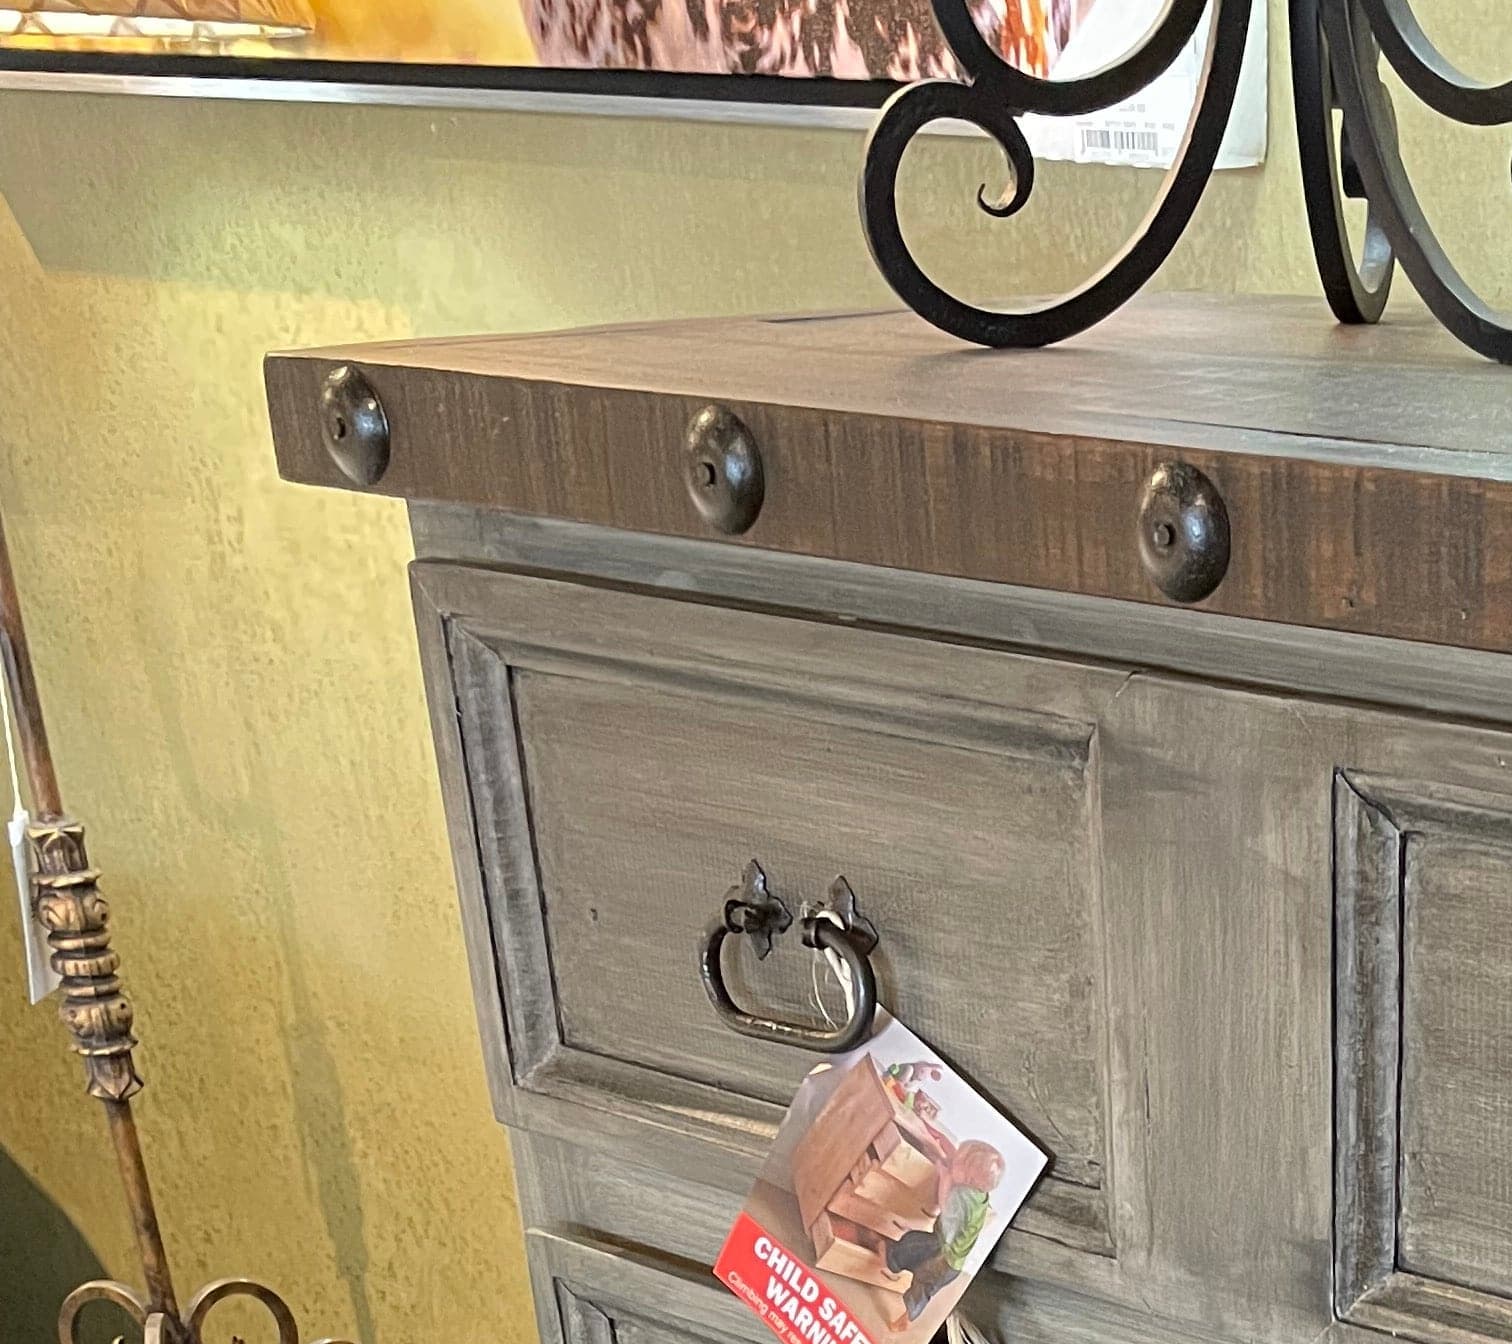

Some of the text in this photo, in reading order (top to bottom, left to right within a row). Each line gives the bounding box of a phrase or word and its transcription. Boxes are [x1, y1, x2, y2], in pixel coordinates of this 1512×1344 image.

[754, 1237, 819, 1303] CHILD
[727, 1271, 769, 1316] Climbing
[769, 1311, 789, 1334] may
